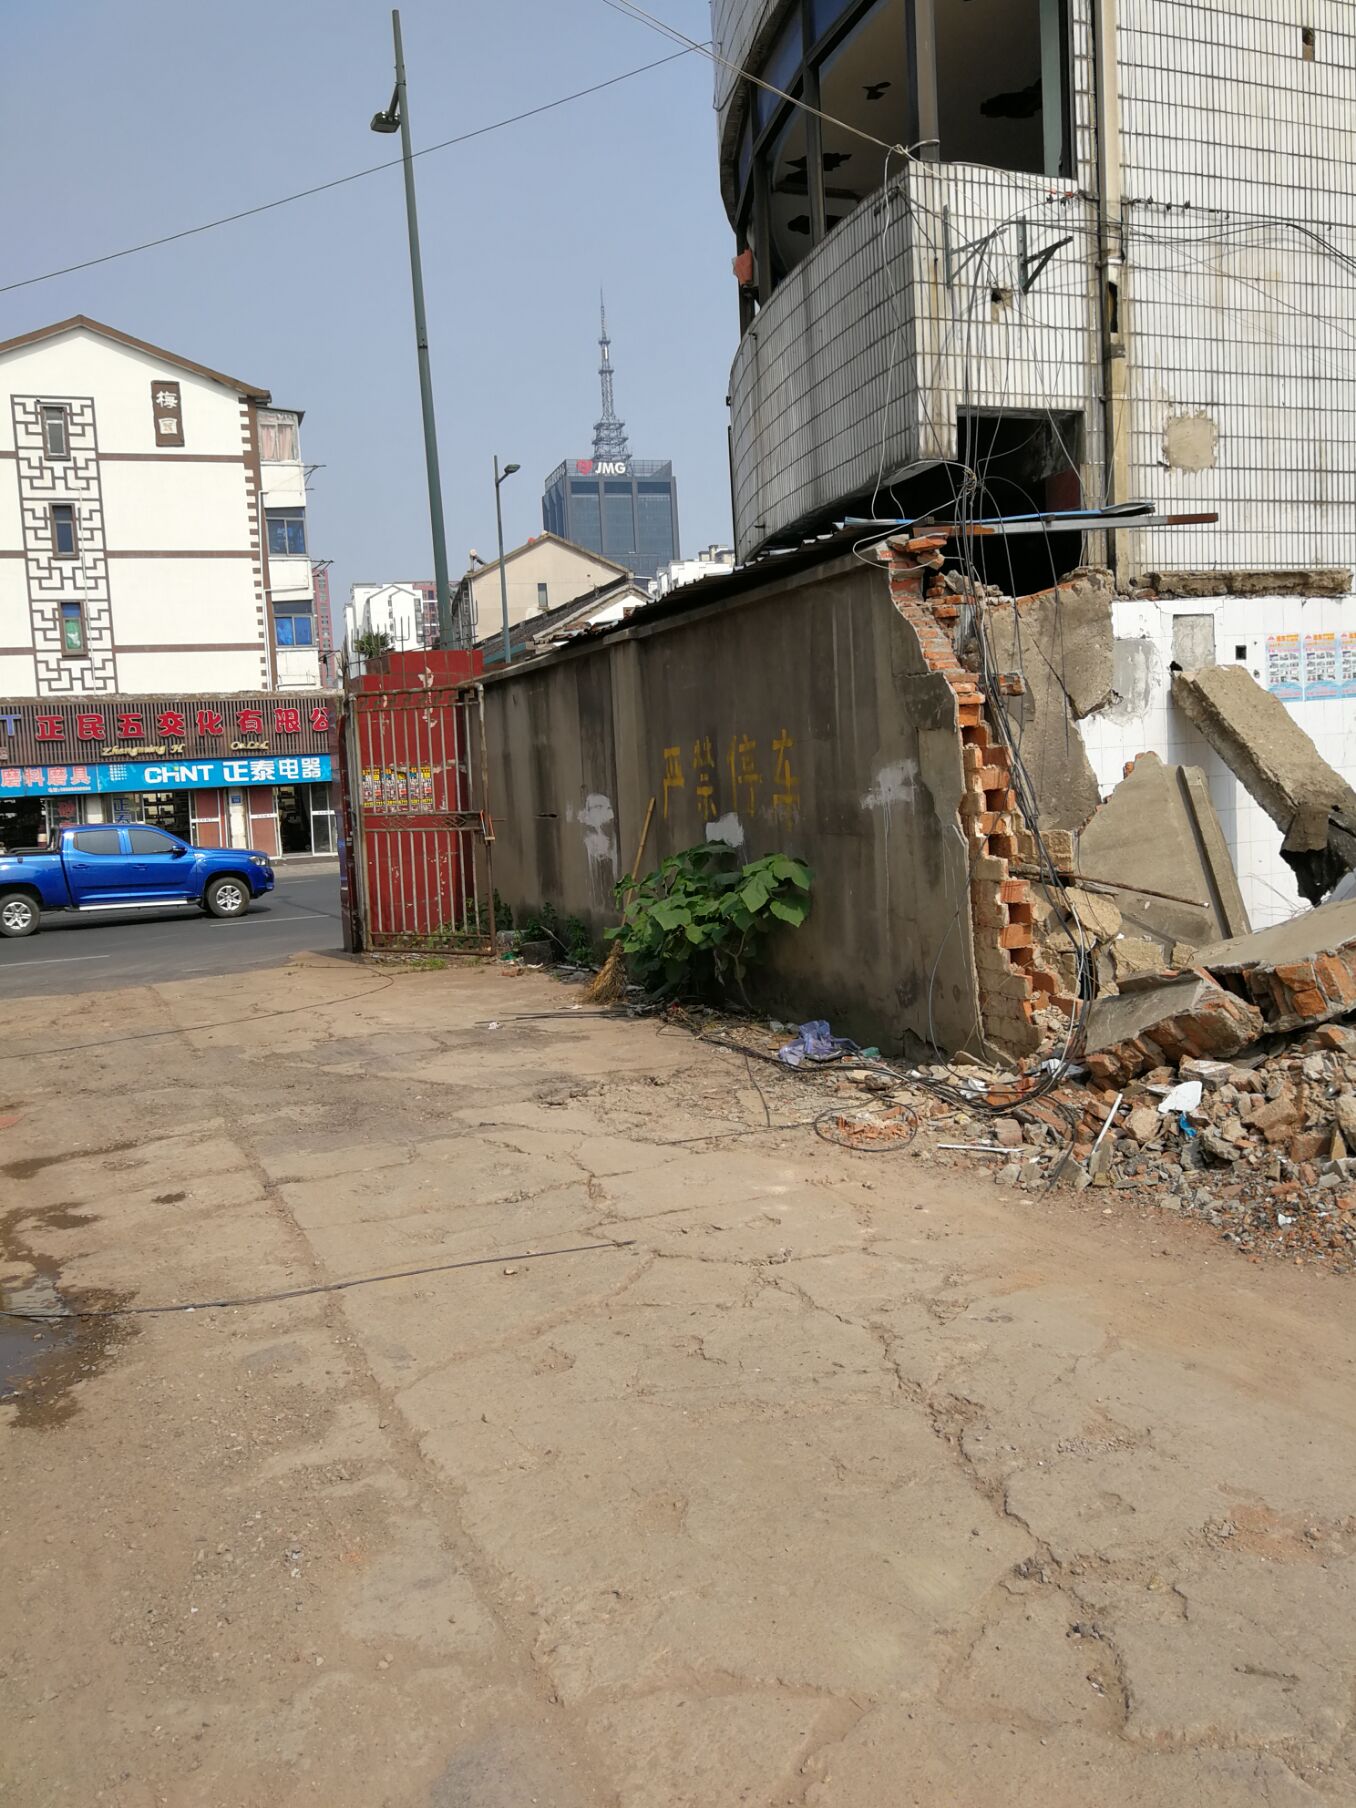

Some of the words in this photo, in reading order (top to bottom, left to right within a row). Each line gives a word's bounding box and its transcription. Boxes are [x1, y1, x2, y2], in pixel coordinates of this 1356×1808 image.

[595, 461, 626, 474] JMG
[223, 757, 321, 782] 正泰电器
[662, 728, 800, 832] 严禁停车
